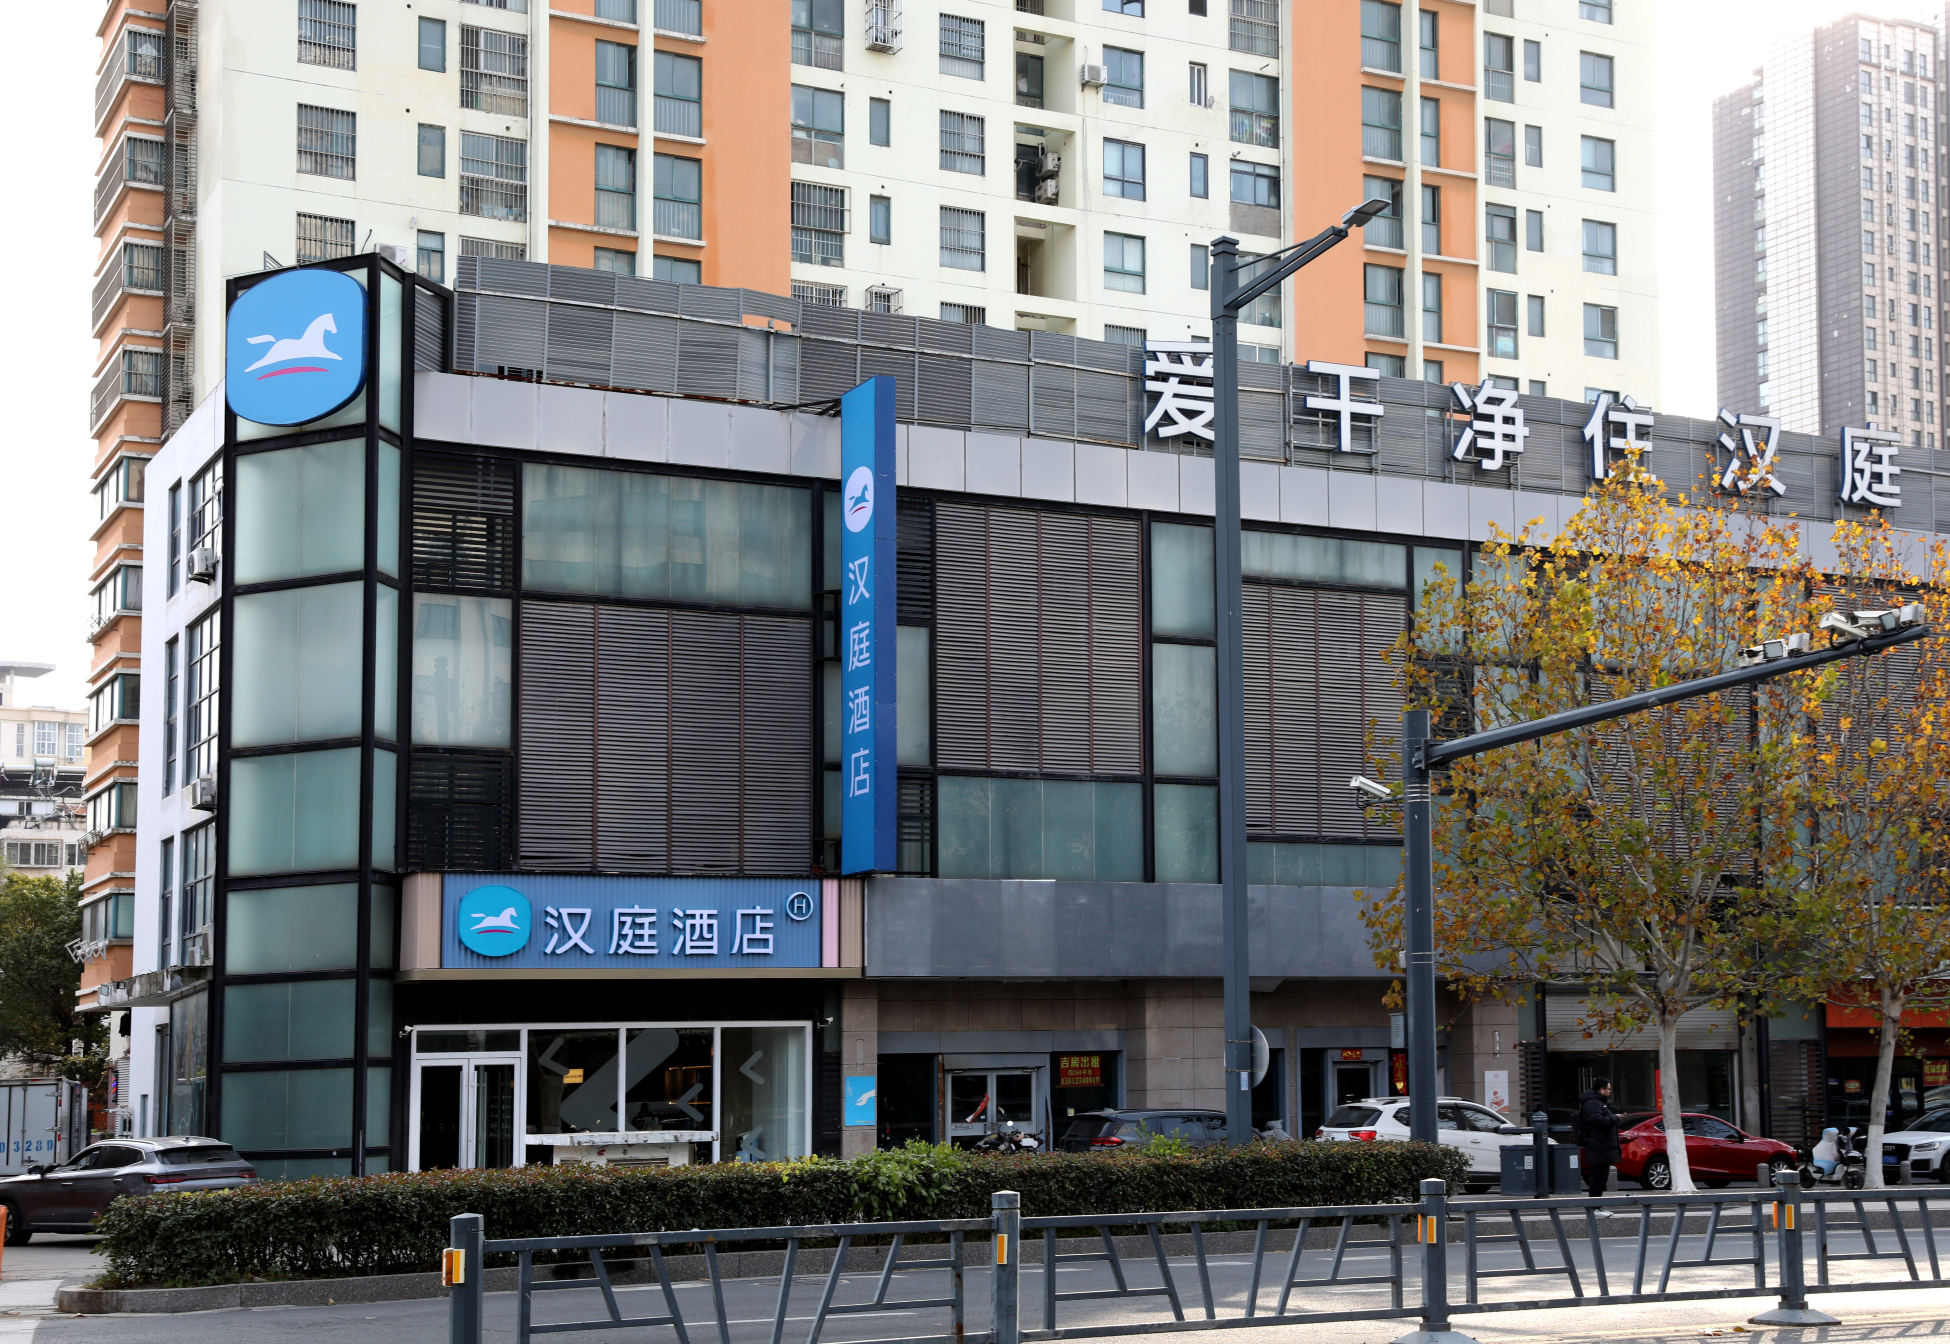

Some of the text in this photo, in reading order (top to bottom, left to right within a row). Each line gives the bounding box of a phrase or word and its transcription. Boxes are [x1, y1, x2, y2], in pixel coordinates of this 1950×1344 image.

[1142, 340, 1902, 508] 爱干净住汉庭
[848, 555, 871, 798] 汉庭酒店
[544, 904, 774, 955] 汉庭酒店
[1060, 1056, 1100, 1068] 吉房出租
